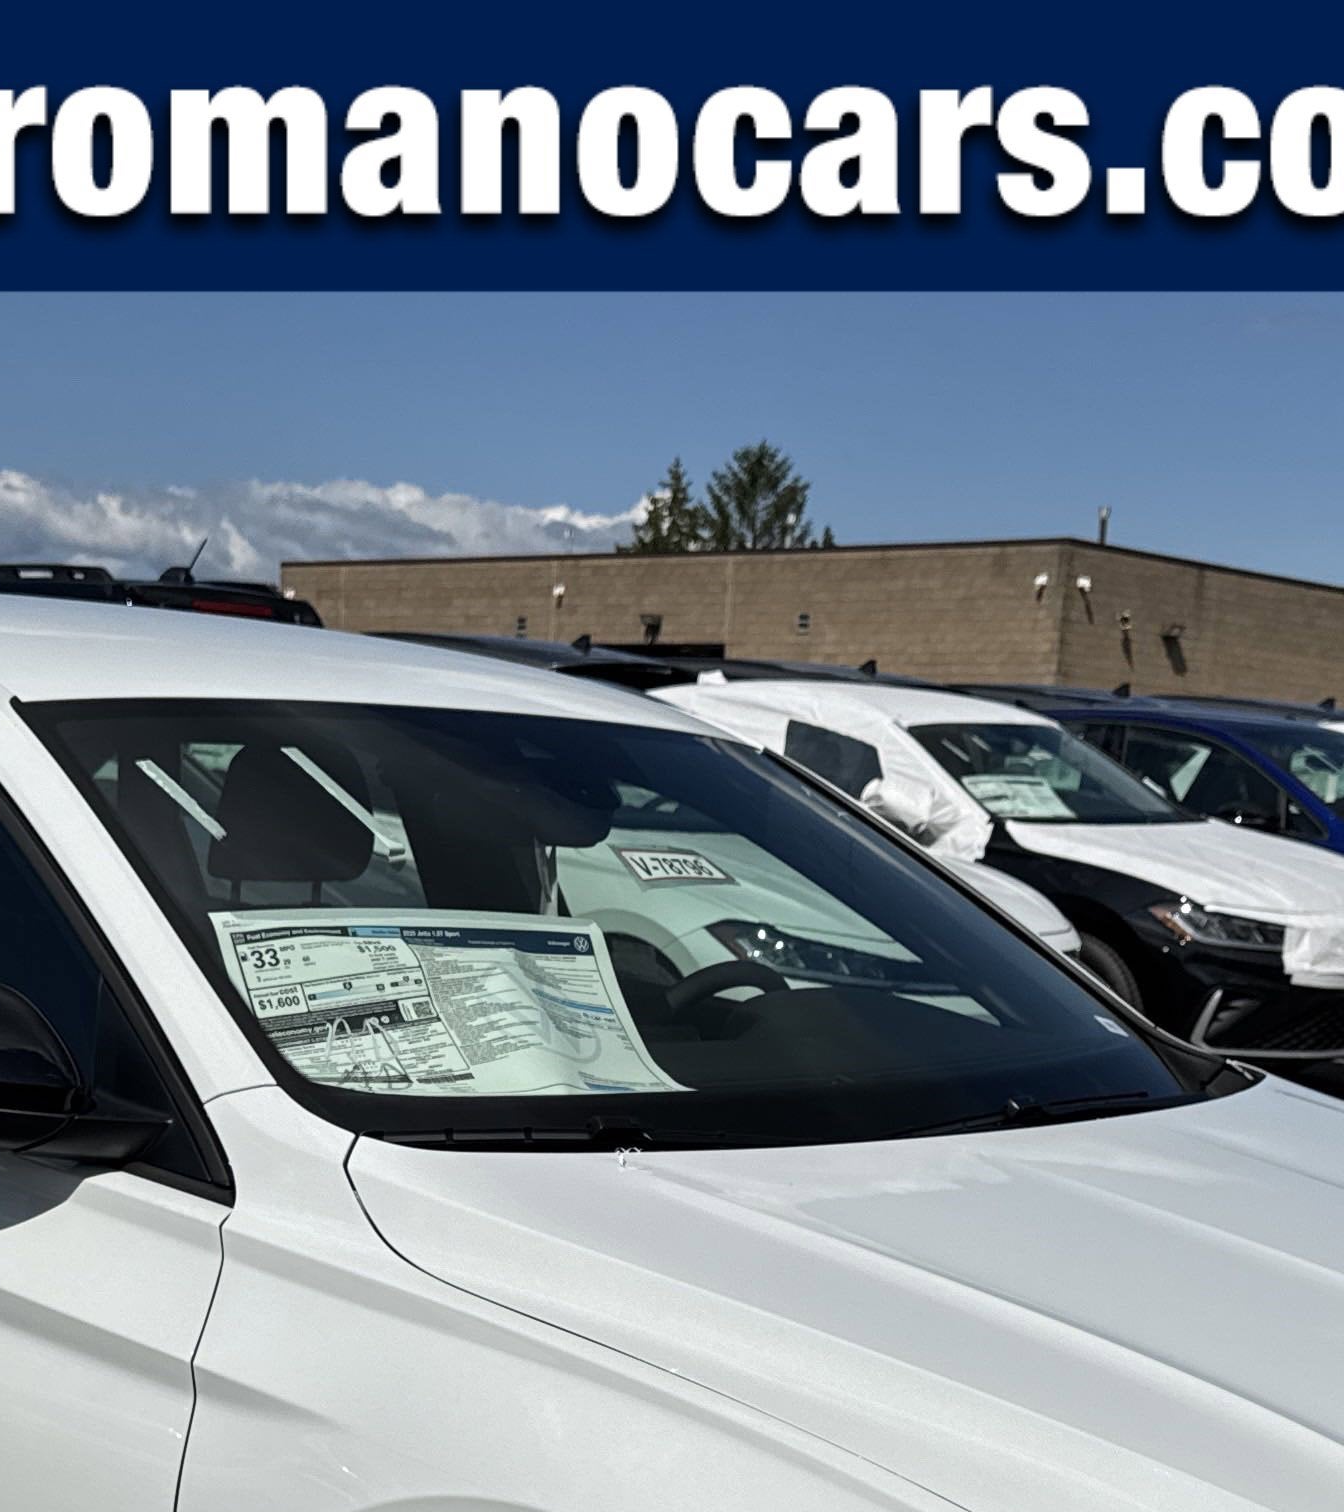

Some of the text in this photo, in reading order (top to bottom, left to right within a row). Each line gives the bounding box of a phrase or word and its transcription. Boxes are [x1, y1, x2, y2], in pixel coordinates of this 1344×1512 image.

[629, 856, 714, 876] V-78796
[250, 948, 280, 969] 33
[258, 995, 301, 1011] $1,600
